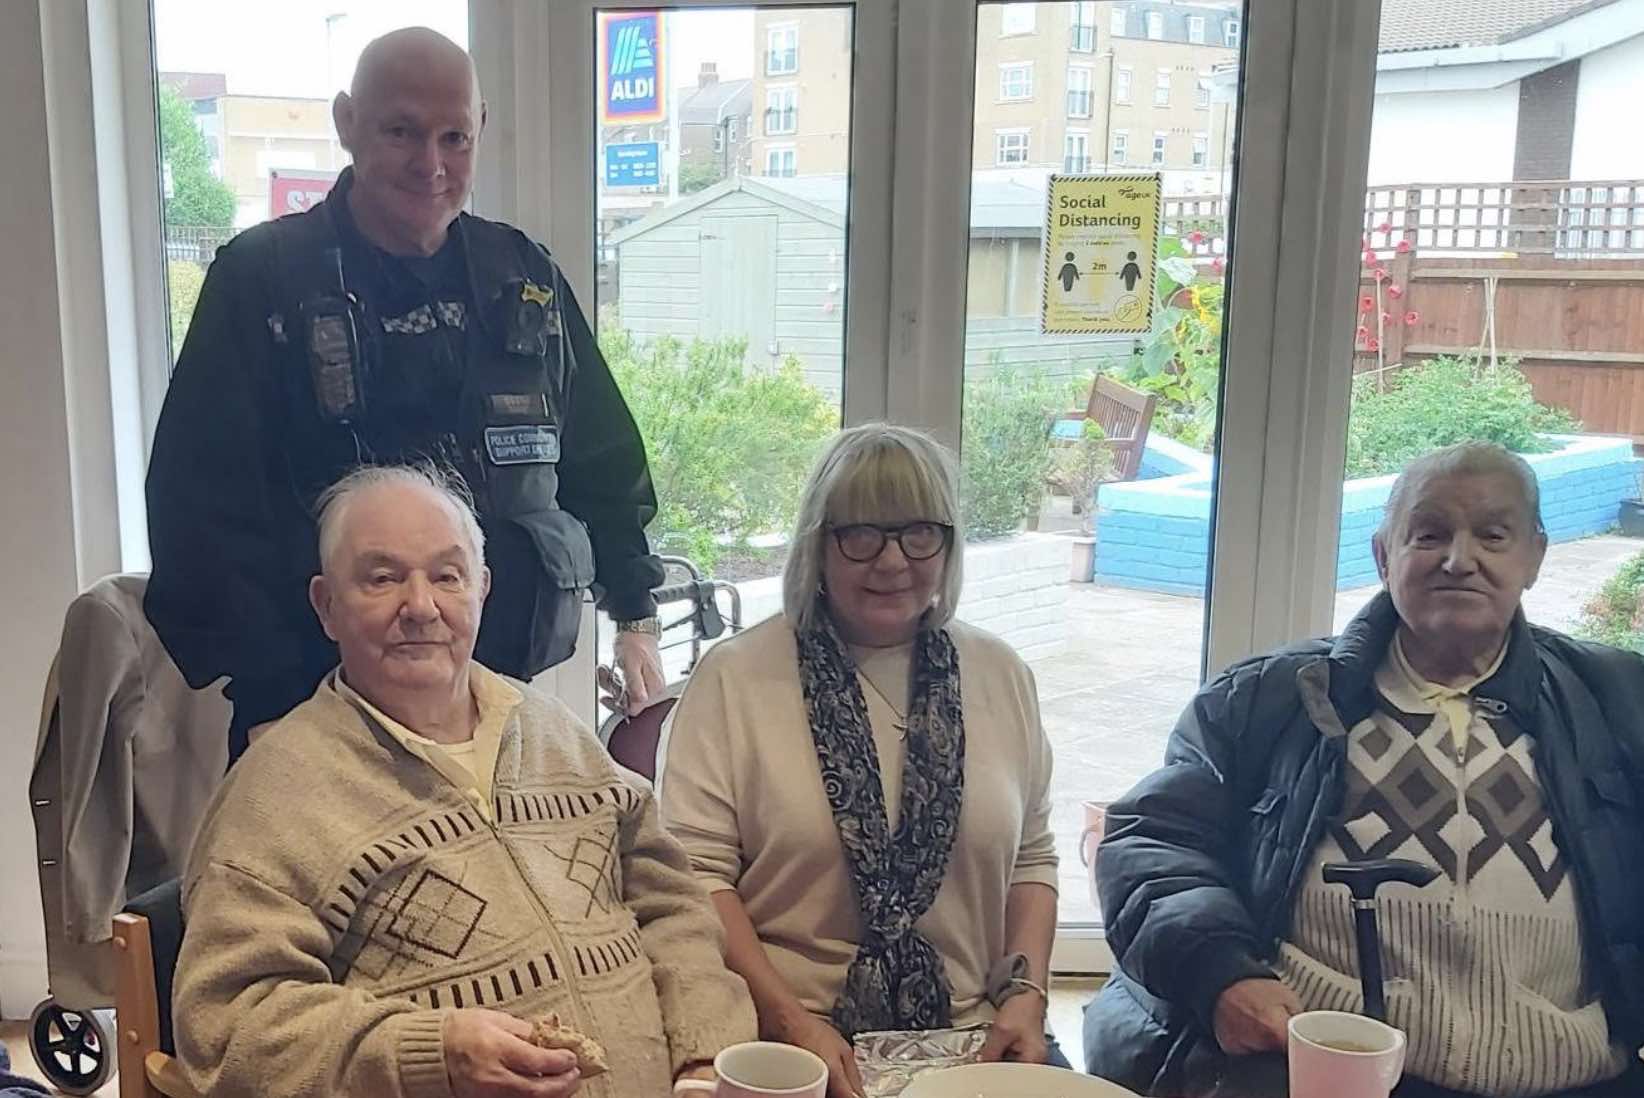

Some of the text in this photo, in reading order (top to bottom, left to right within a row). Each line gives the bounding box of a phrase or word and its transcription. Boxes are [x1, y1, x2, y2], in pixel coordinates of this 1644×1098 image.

[611, 78, 654, 100] ALDI
[1059, 194, 1106, 209] Social
[1059, 212, 1141, 230] Distancing
[1092, 262, 1107, 271] 2m
